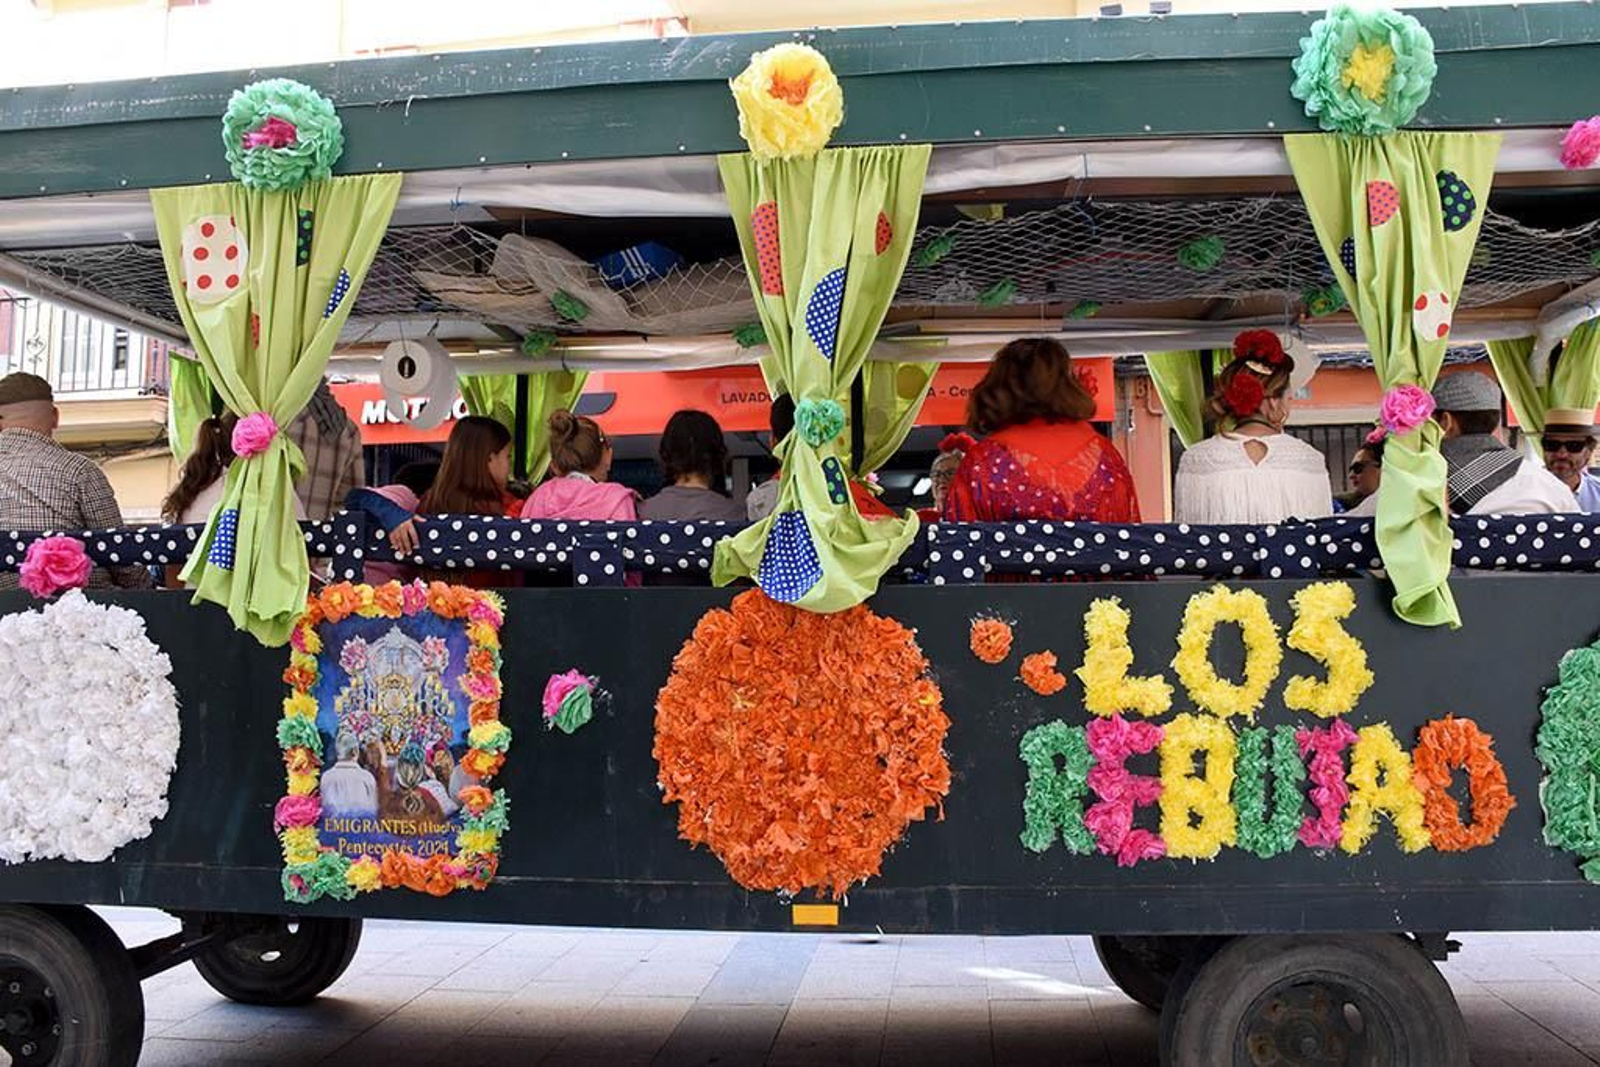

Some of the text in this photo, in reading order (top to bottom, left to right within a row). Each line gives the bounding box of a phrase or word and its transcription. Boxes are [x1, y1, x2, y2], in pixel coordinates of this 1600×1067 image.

[1075, 580, 1375, 718] LOS
[324, 818, 417, 835] EMIGRANTES
[418, 839, 450, 856] 2024
